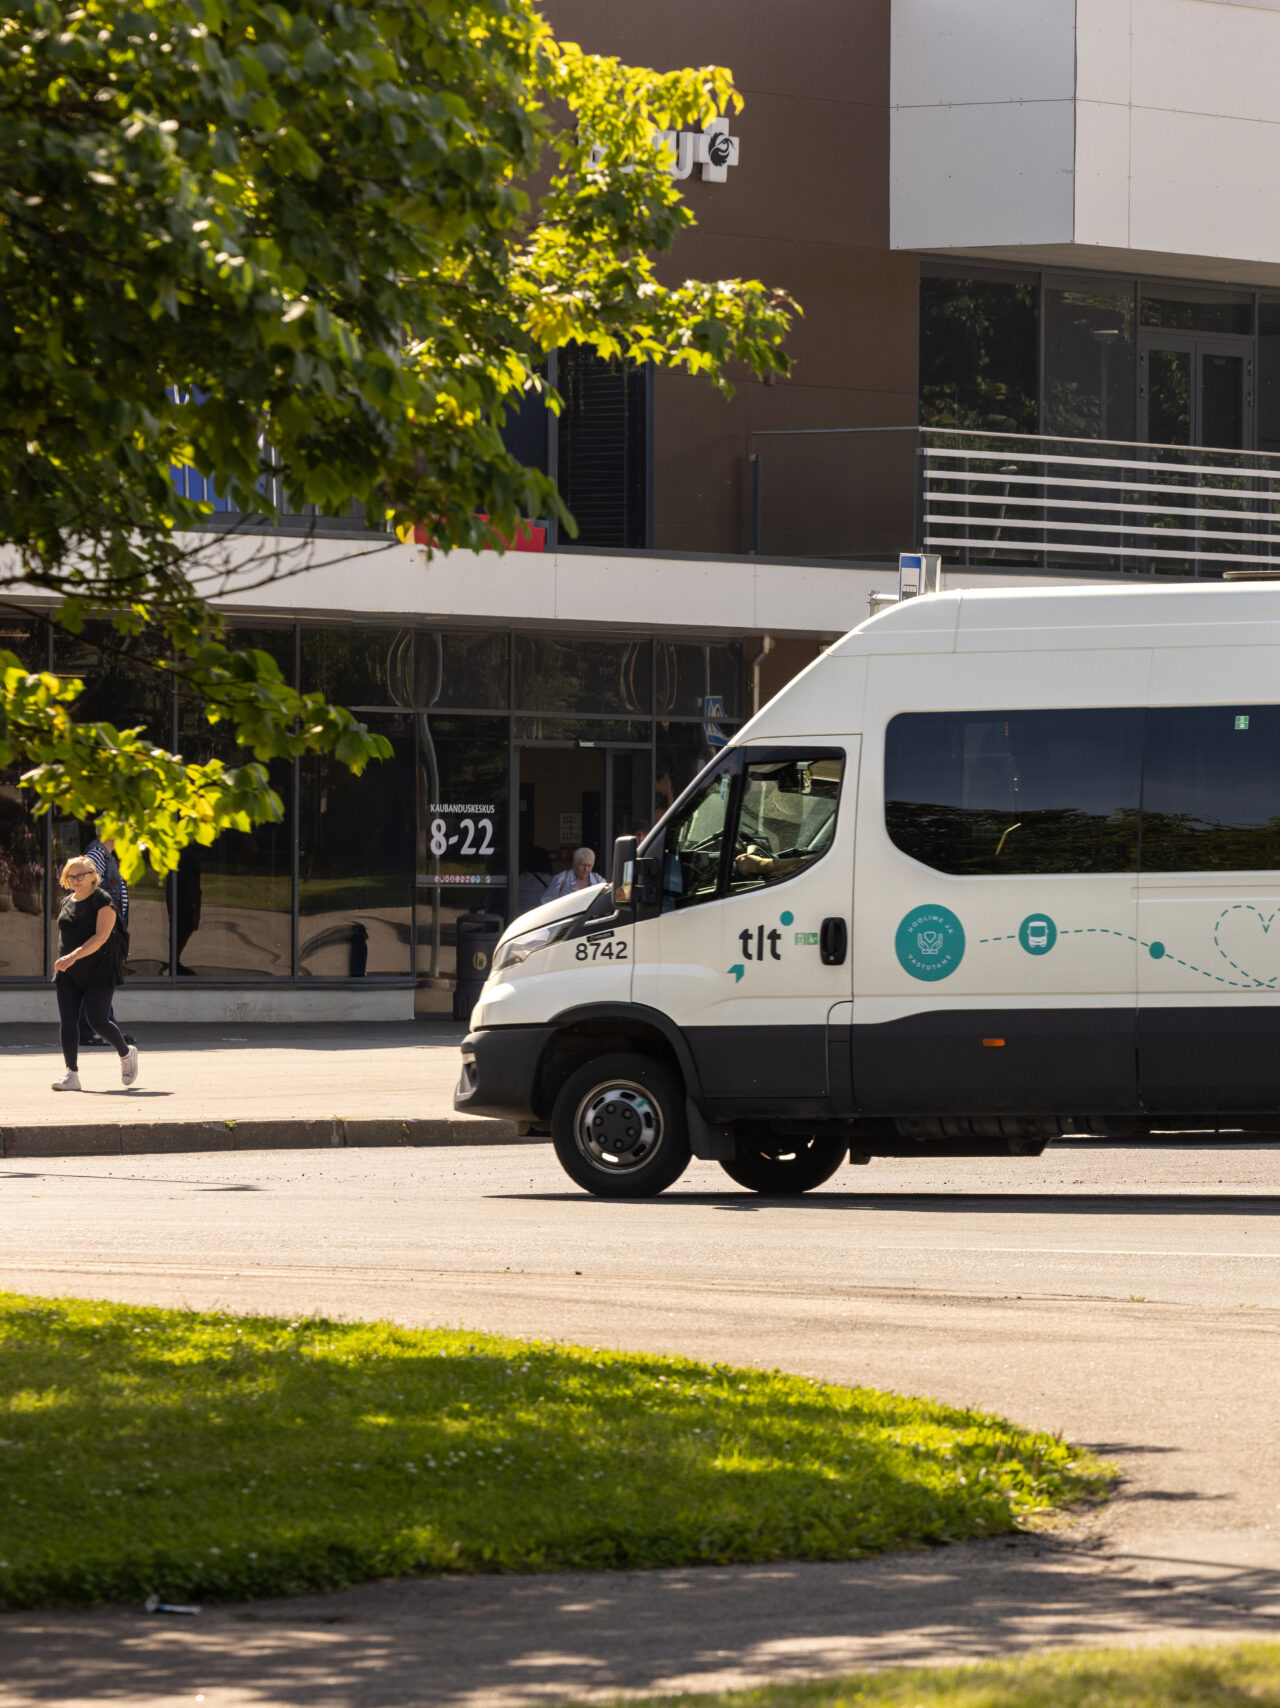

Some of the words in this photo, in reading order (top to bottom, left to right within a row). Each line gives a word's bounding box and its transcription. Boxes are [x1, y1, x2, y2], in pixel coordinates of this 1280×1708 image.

[430, 803, 495, 814] KAUBANDUSKESKUS
[430, 818, 495, 856] 8-22
[908, 915, 944, 933] HOOLIME
[575, 941, 628, 961] 8742
[738, 924, 782, 961] tlt
[907, 953, 951, 970] VASTUTAME
